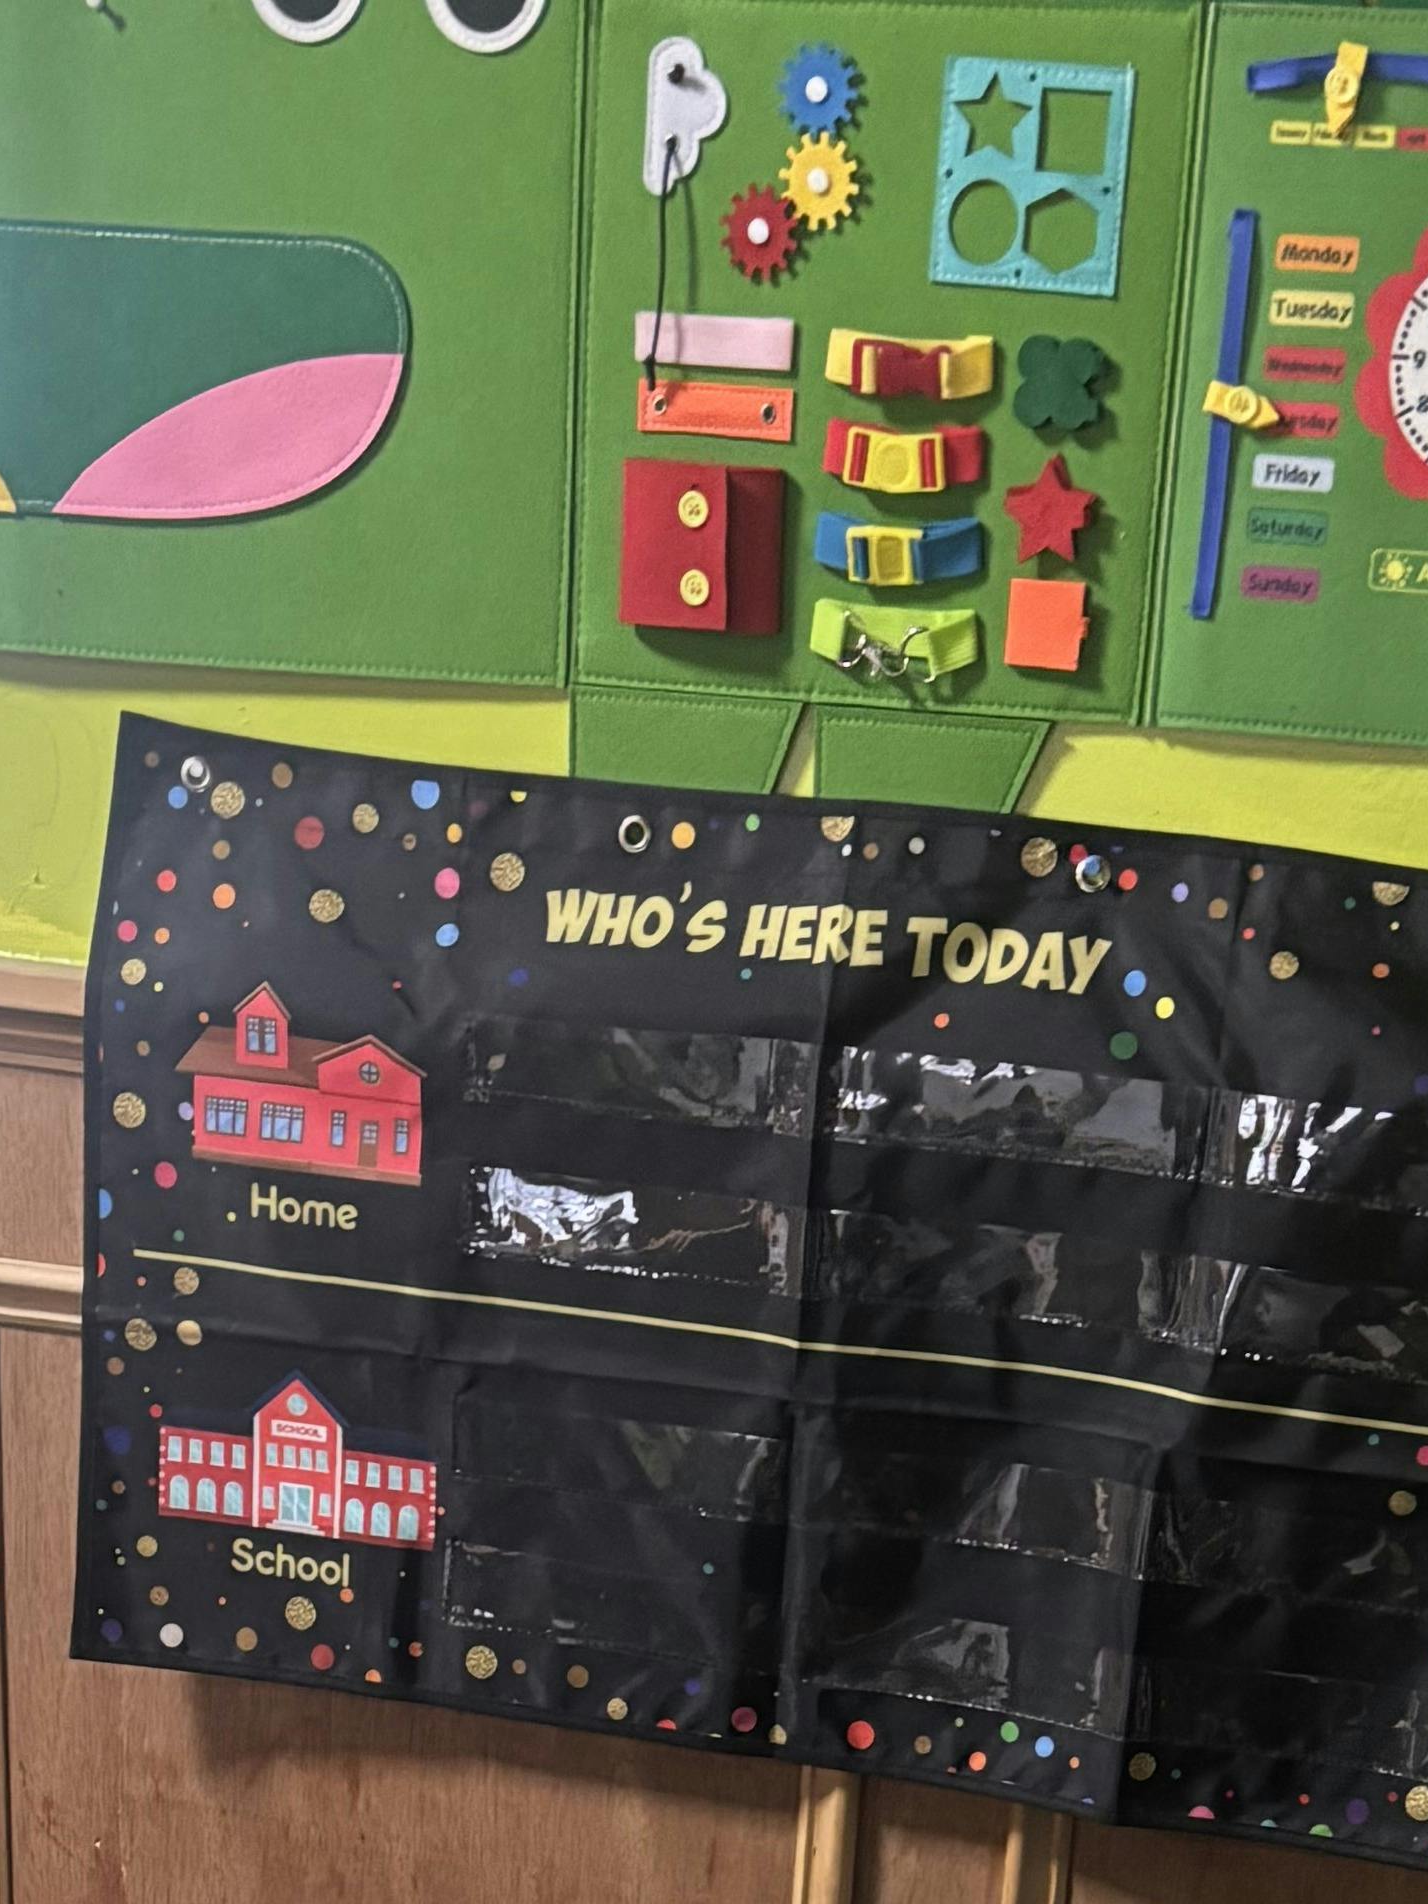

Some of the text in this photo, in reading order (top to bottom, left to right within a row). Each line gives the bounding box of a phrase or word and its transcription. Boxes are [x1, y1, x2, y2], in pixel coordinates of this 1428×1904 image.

[1281, 244, 1353, 267] Monday
[1274, 298, 1352, 322] Tuesday
[1413, 349, 1427, 369] 9
[1264, 463, 1321, 487] Friday
[1250, 517, 1324, 541] Saturday
[1248, 573, 1313, 599] Sunday
[546, 880, 1112, 995] WHO'S HERE TODAY
[251, 1182, 358, 1230] Home
[276, 1422, 324, 1439] SCHOOL
[231, 1538, 350, 1587] School
